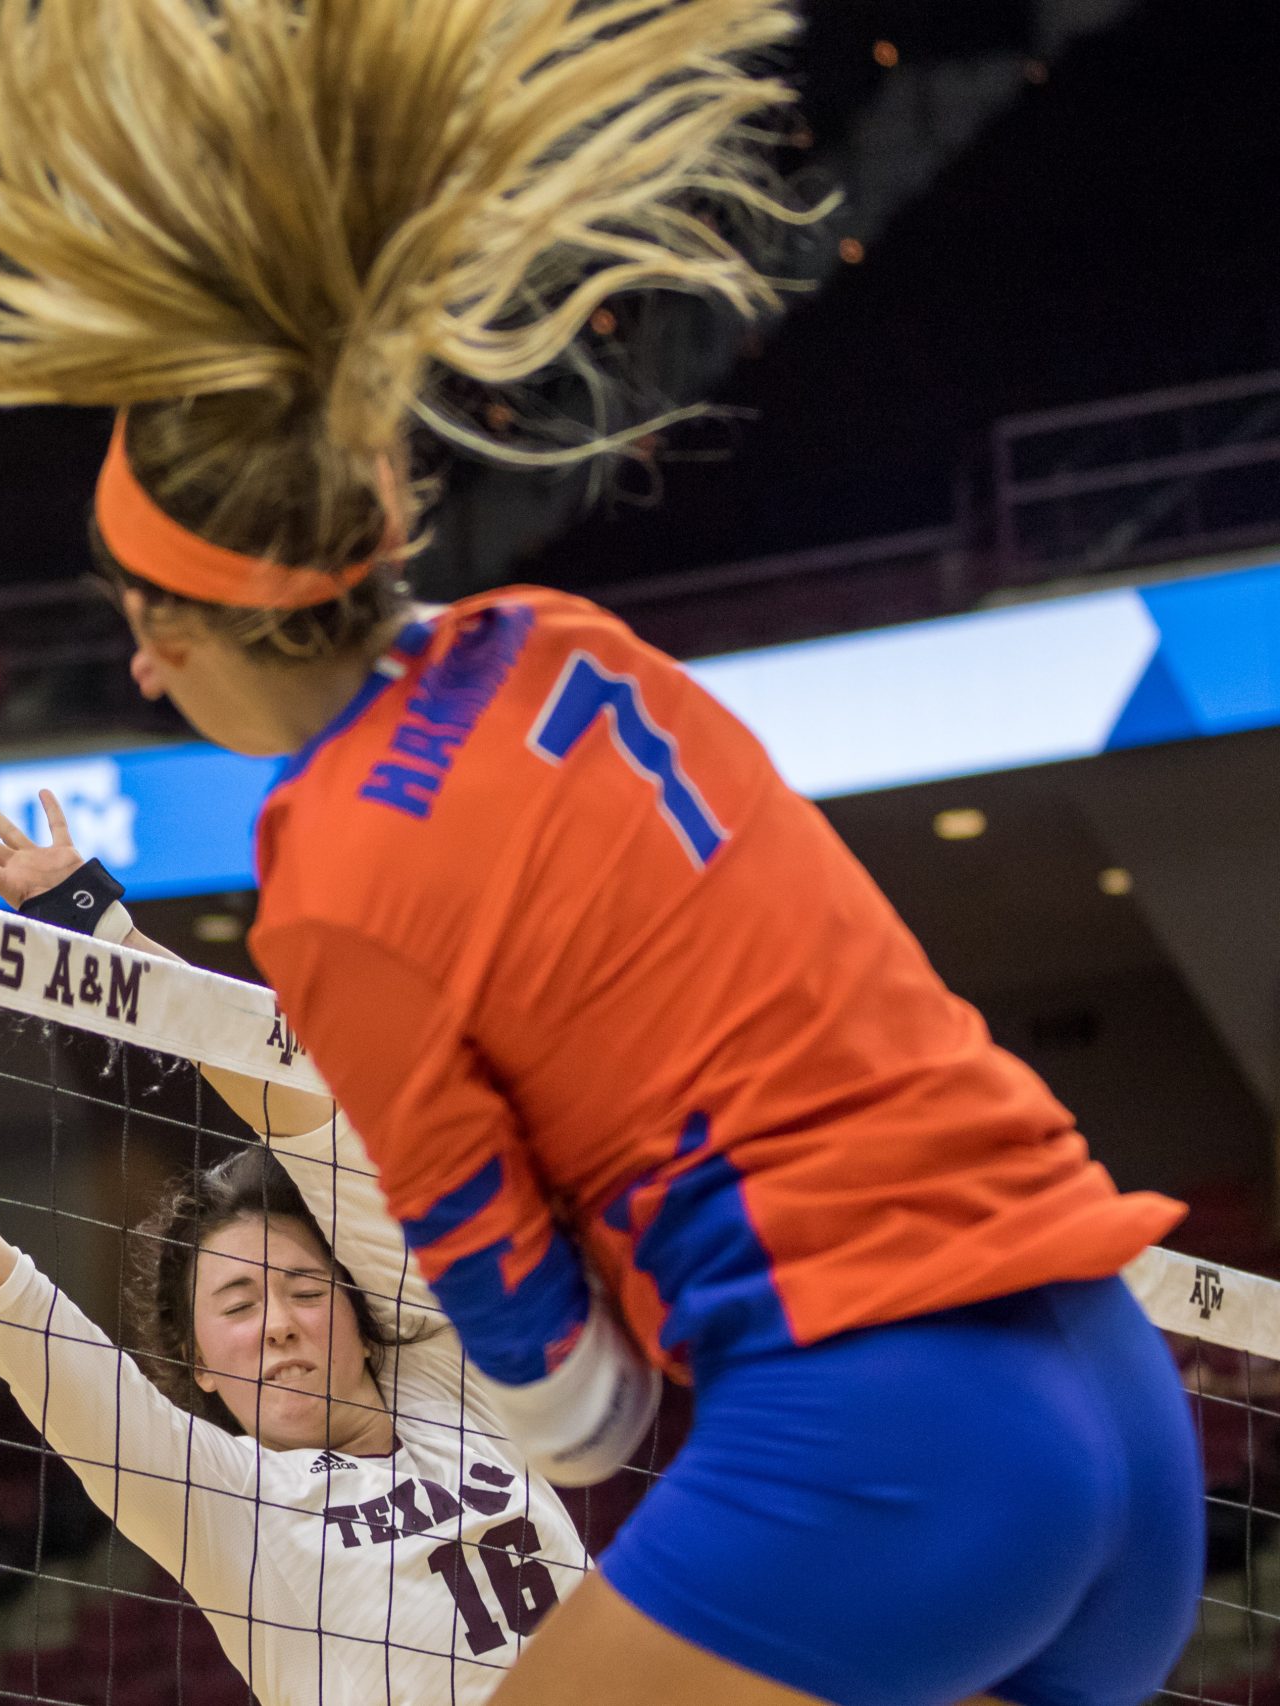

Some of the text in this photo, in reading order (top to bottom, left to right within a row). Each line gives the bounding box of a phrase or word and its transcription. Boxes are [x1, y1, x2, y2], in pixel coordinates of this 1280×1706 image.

[526, 648, 733, 875] 7
[43, 937, 143, 1026] A&M
[309, 1462, 359, 1474] adidas
[427, 1516, 560, 1657] 16
